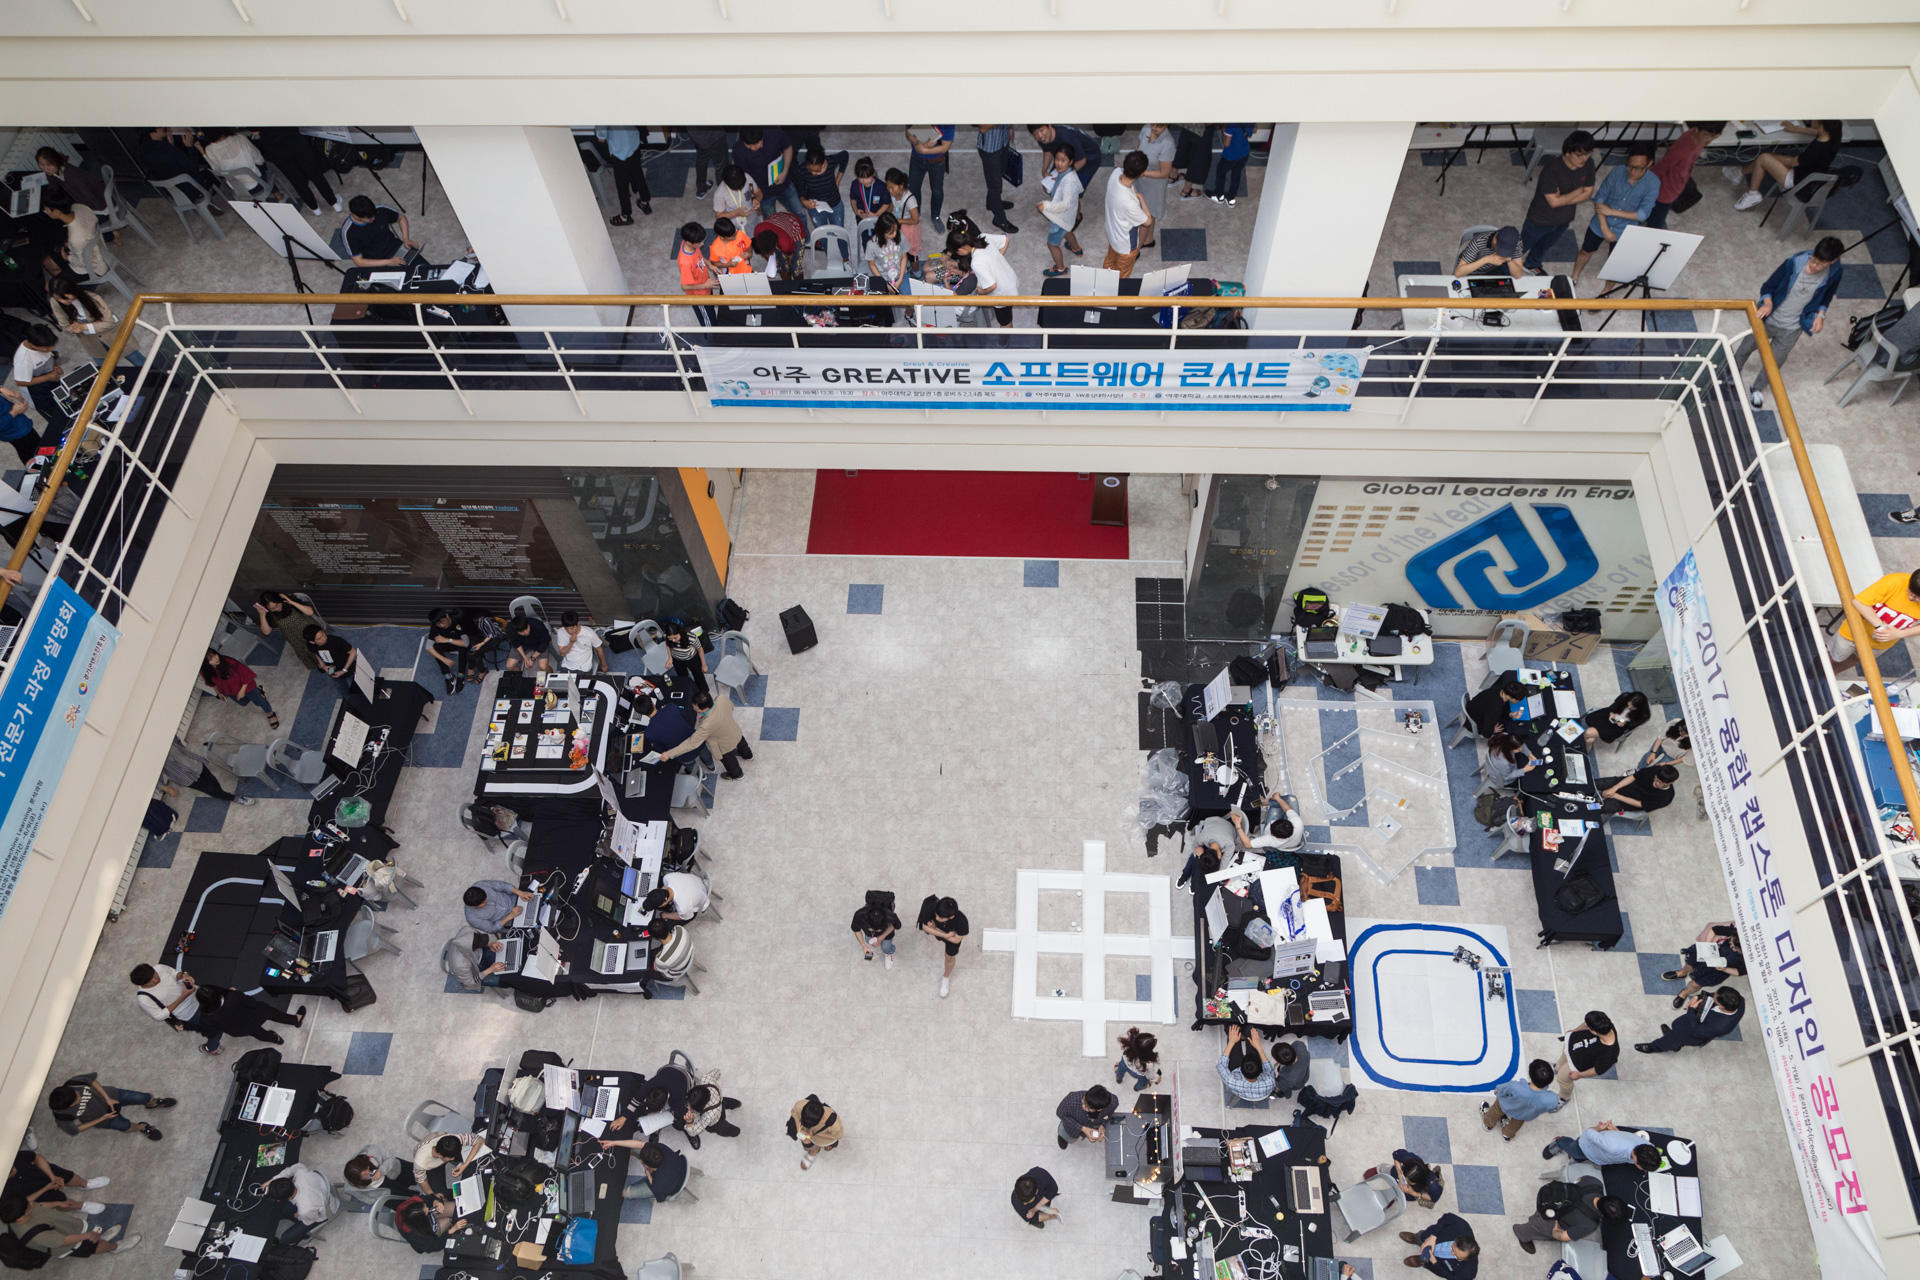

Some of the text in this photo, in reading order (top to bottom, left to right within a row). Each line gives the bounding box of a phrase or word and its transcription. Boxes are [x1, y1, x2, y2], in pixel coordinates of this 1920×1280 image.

[753, 362, 1290, 387] 아주 GREATIVE 소프트웨어 콘서트
[1363, 483, 1445, 496] Global
[1452, 484, 1548, 498] Leaders
[1371, 543, 1396, 565] of
[1389, 526, 1437, 559] the
[1425, 495, 1492, 534] Year
[1607, 563, 1640, 584] of
[0, 600, 76, 763] 전문가 과정 설명회
[18, 807, 32, 836] Learning
[1696, 622, 1866, 1215] 2017 융합 캡스톤 디자인 공모전
[1766, 993, 1775, 1012] 2017.
[1771, 987, 1780, 1007] 2017.
